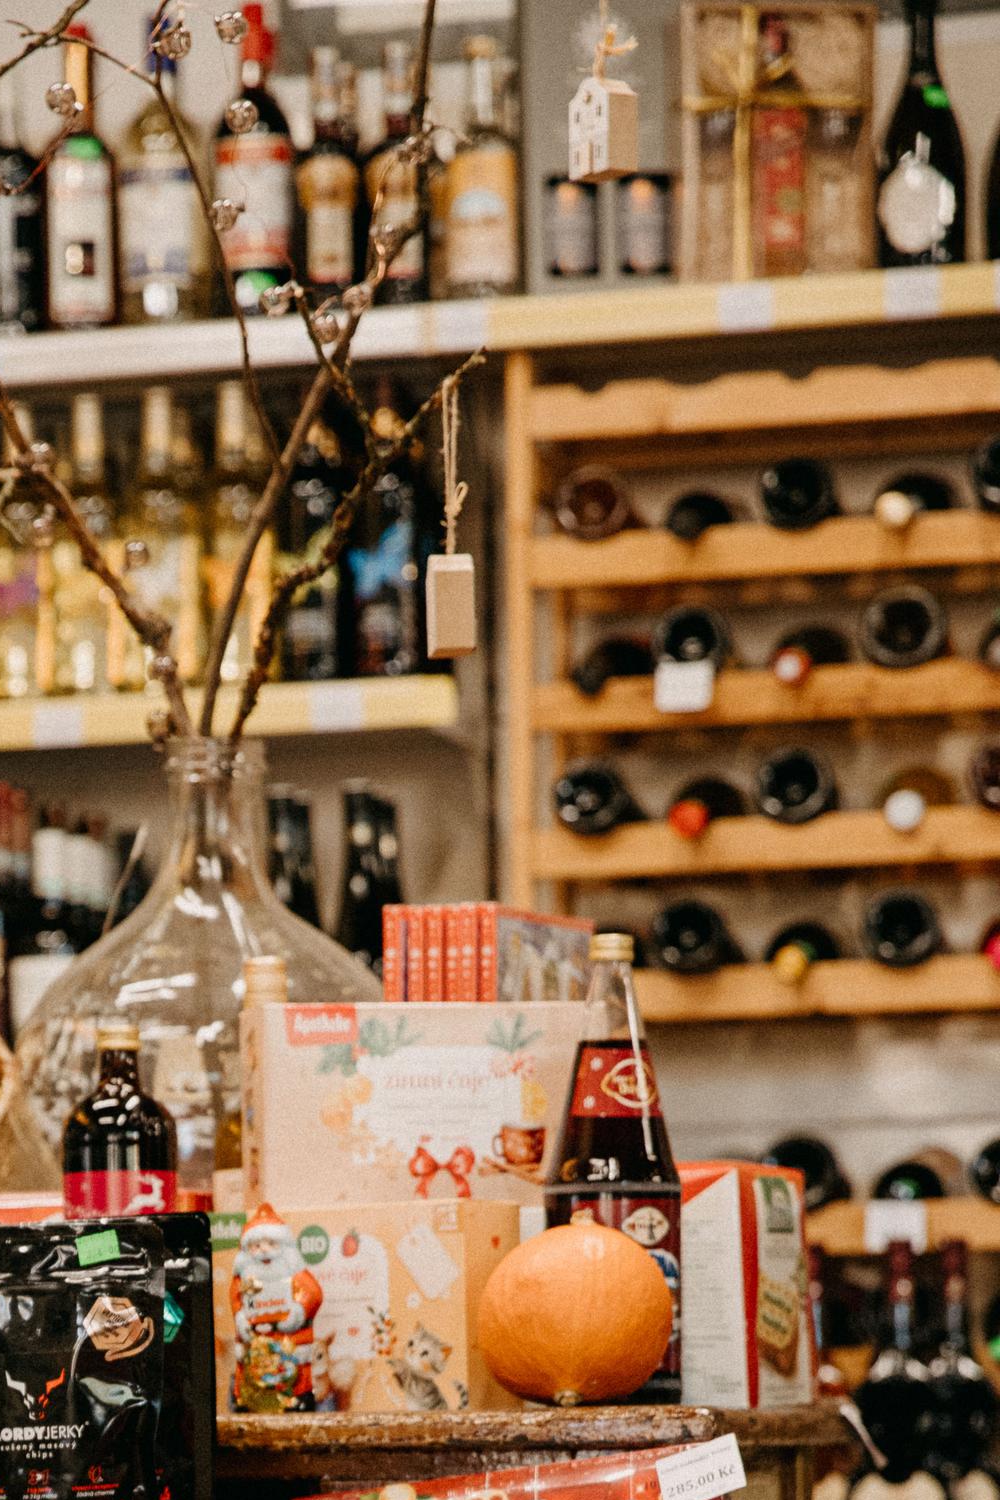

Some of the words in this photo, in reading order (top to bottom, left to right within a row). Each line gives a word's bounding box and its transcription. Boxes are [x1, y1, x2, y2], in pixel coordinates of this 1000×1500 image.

[300, 1235, 324, 1249] BIO
[666, 1472, 715, 1498] 285,00
[718, 1463, 738, 1479] Kč
